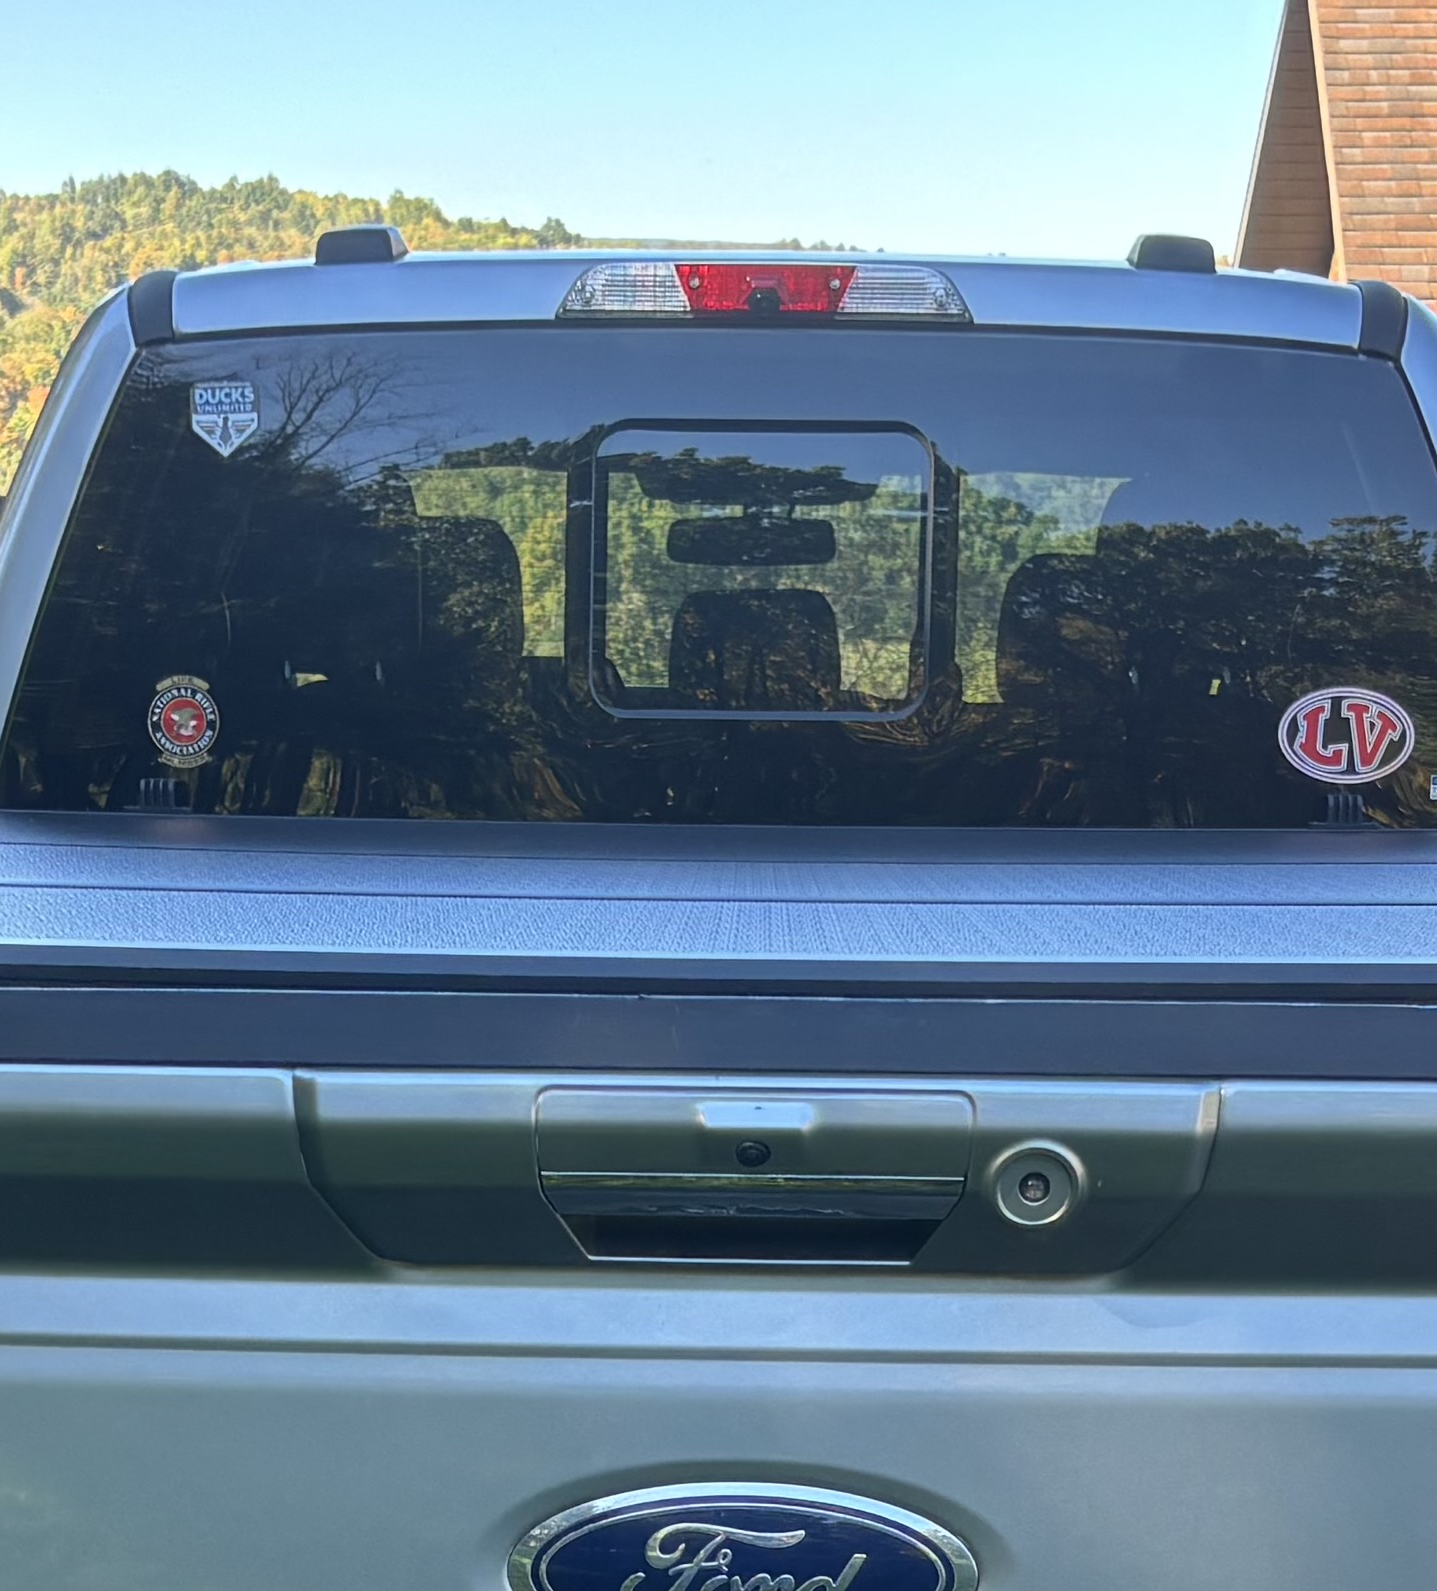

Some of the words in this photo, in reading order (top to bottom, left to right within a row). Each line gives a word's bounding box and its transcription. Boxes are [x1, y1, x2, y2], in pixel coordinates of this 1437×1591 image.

[194, 387, 254, 404] DUCKS
[197, 403, 252, 413] UNLIMITED
[152, 688, 194, 722] NATIONAL
[194, 692, 216, 721] RIFLE
[155, 729, 213, 755] ASSOCIATION
[1293, 698, 1404, 773] LV
